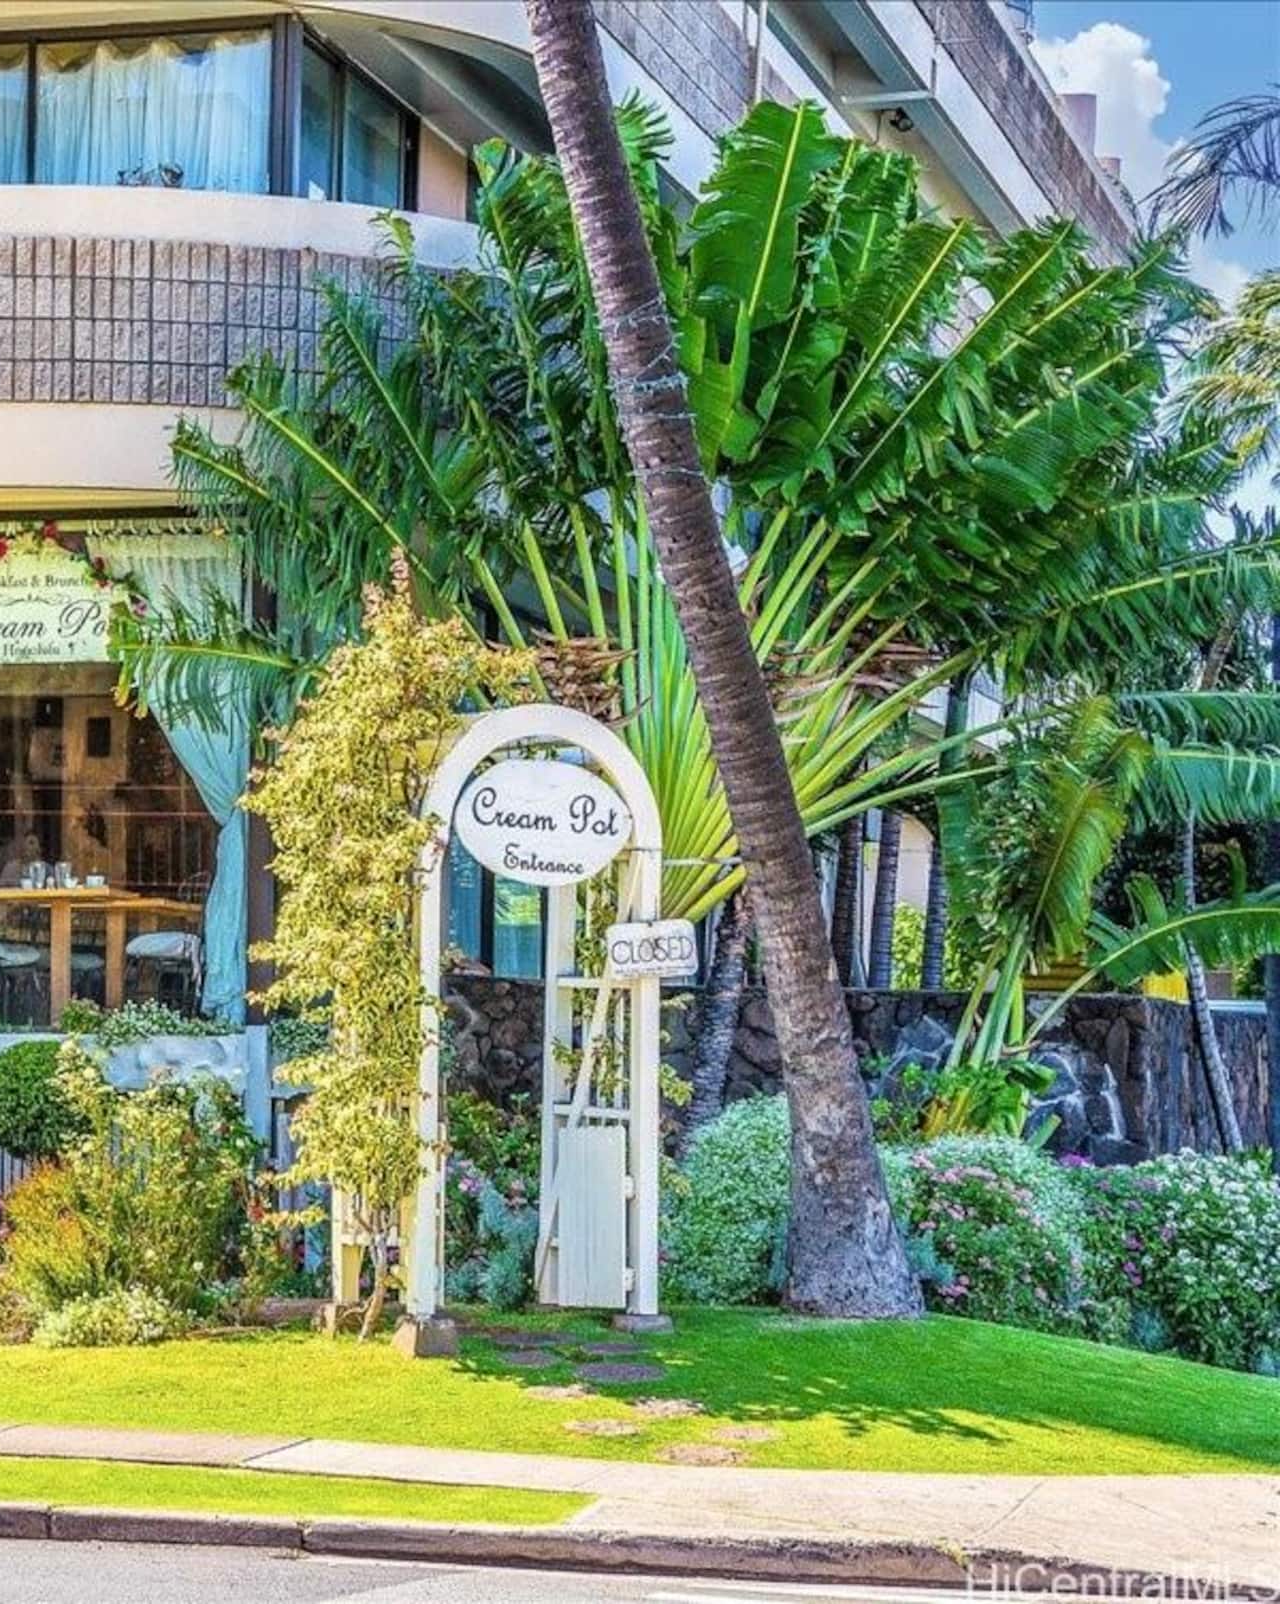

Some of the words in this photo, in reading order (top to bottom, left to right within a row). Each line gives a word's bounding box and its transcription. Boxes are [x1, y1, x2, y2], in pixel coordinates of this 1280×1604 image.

[29, 575, 41, 588] &
[57, 599, 108, 636] Po
[472, 786, 558, 832] Cream
[569, 794, 619, 836] Pot
[503, 843, 585, 875] Entrance
[611, 935, 694, 965] CLOSED
